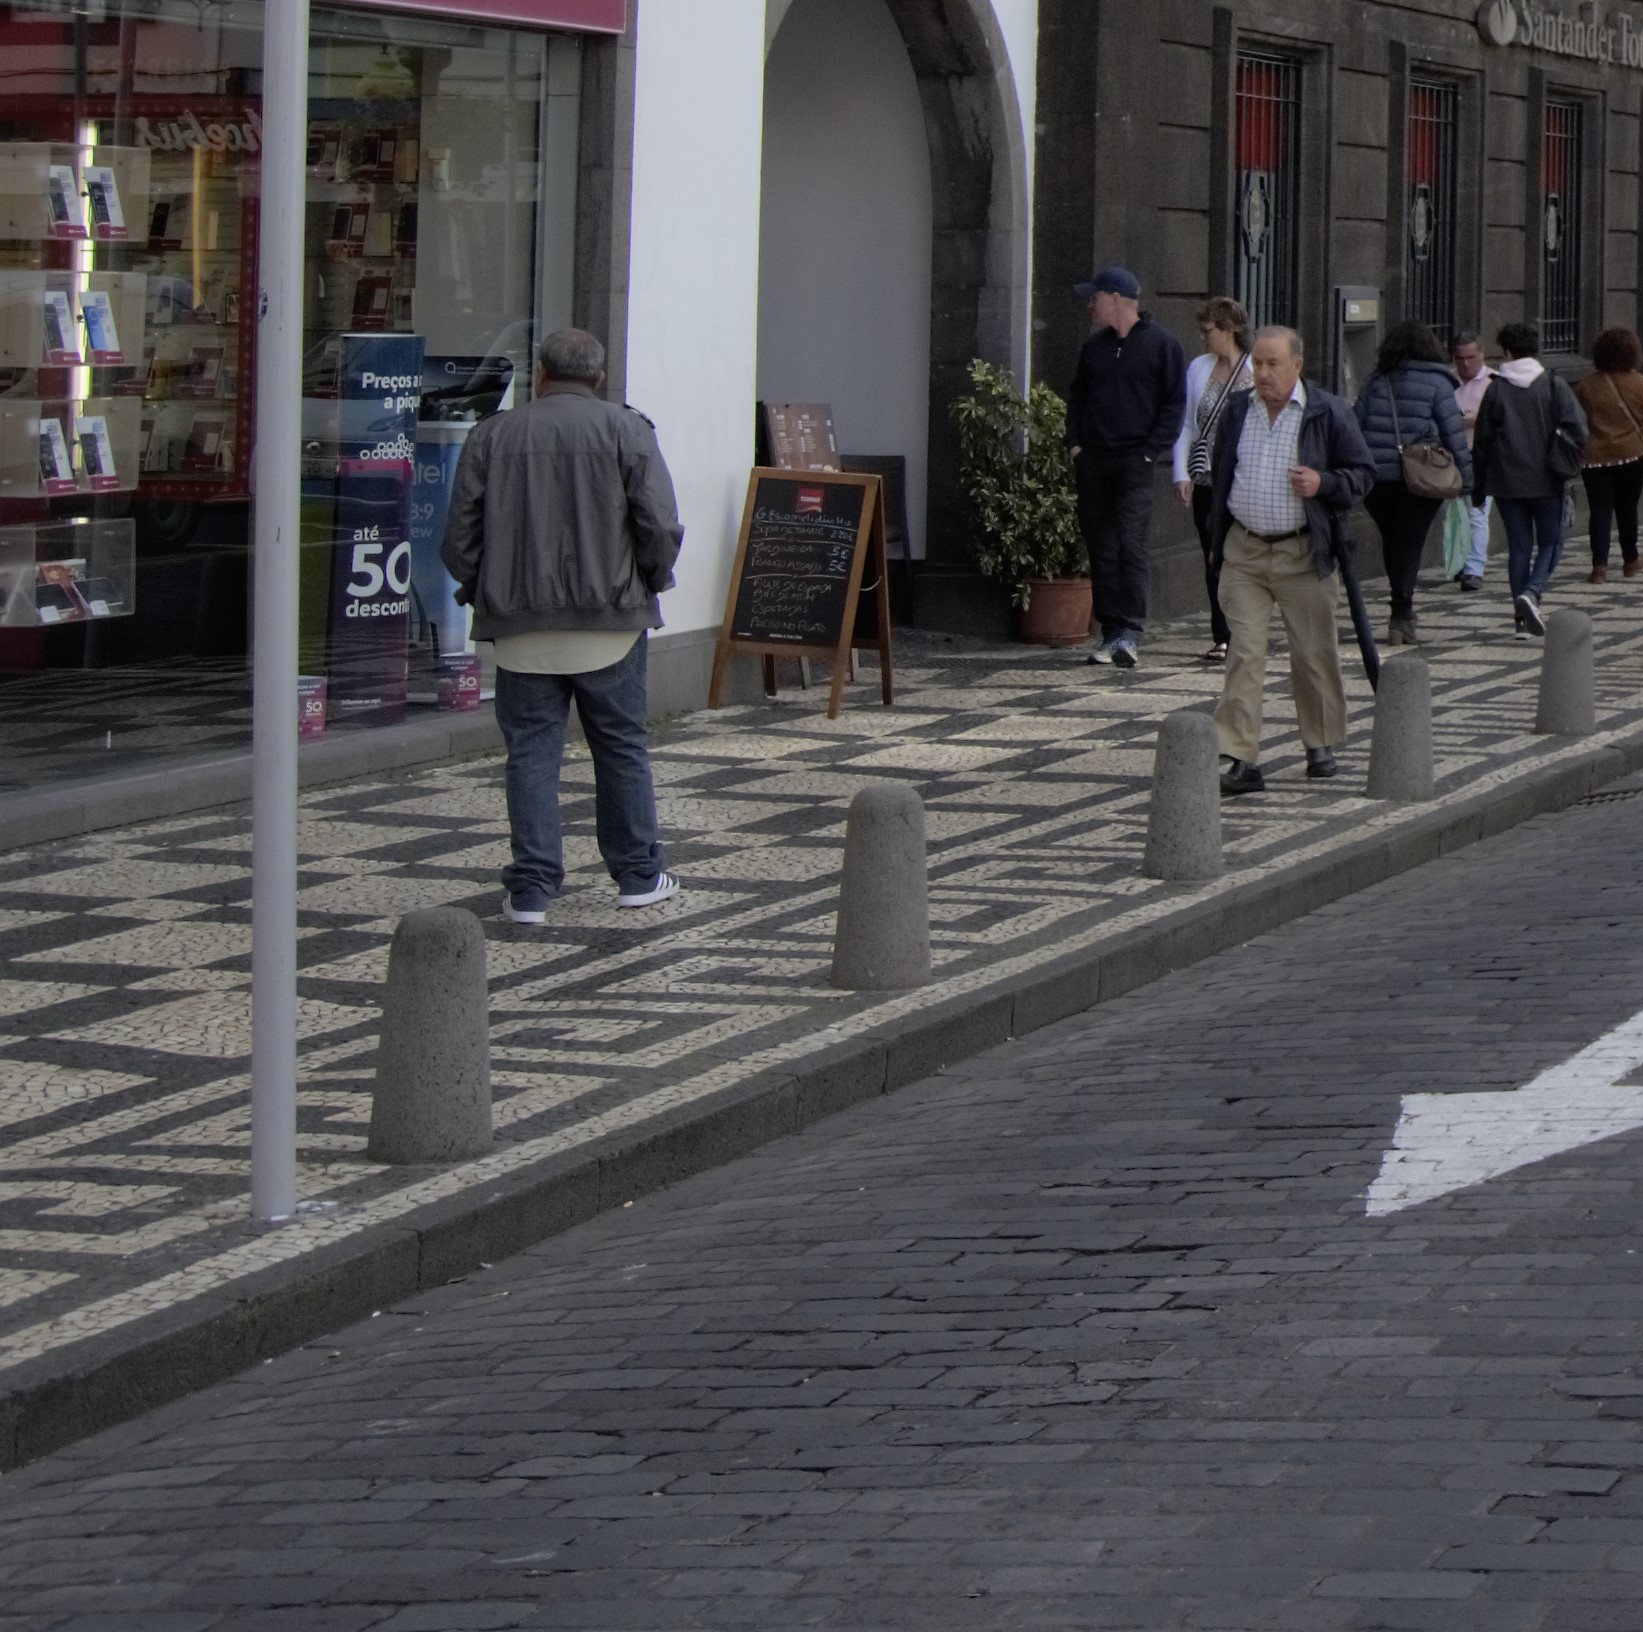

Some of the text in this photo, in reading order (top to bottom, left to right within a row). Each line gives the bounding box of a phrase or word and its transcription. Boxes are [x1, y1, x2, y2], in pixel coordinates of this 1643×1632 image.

[362, 372, 412, 392] Preços
[384, 398, 393, 409] a
[354, 525, 380, 541] até
[347, 541, 411, 597] 50
[459, 677, 477, 687] 50
[306, 701, 323, 713] 50
